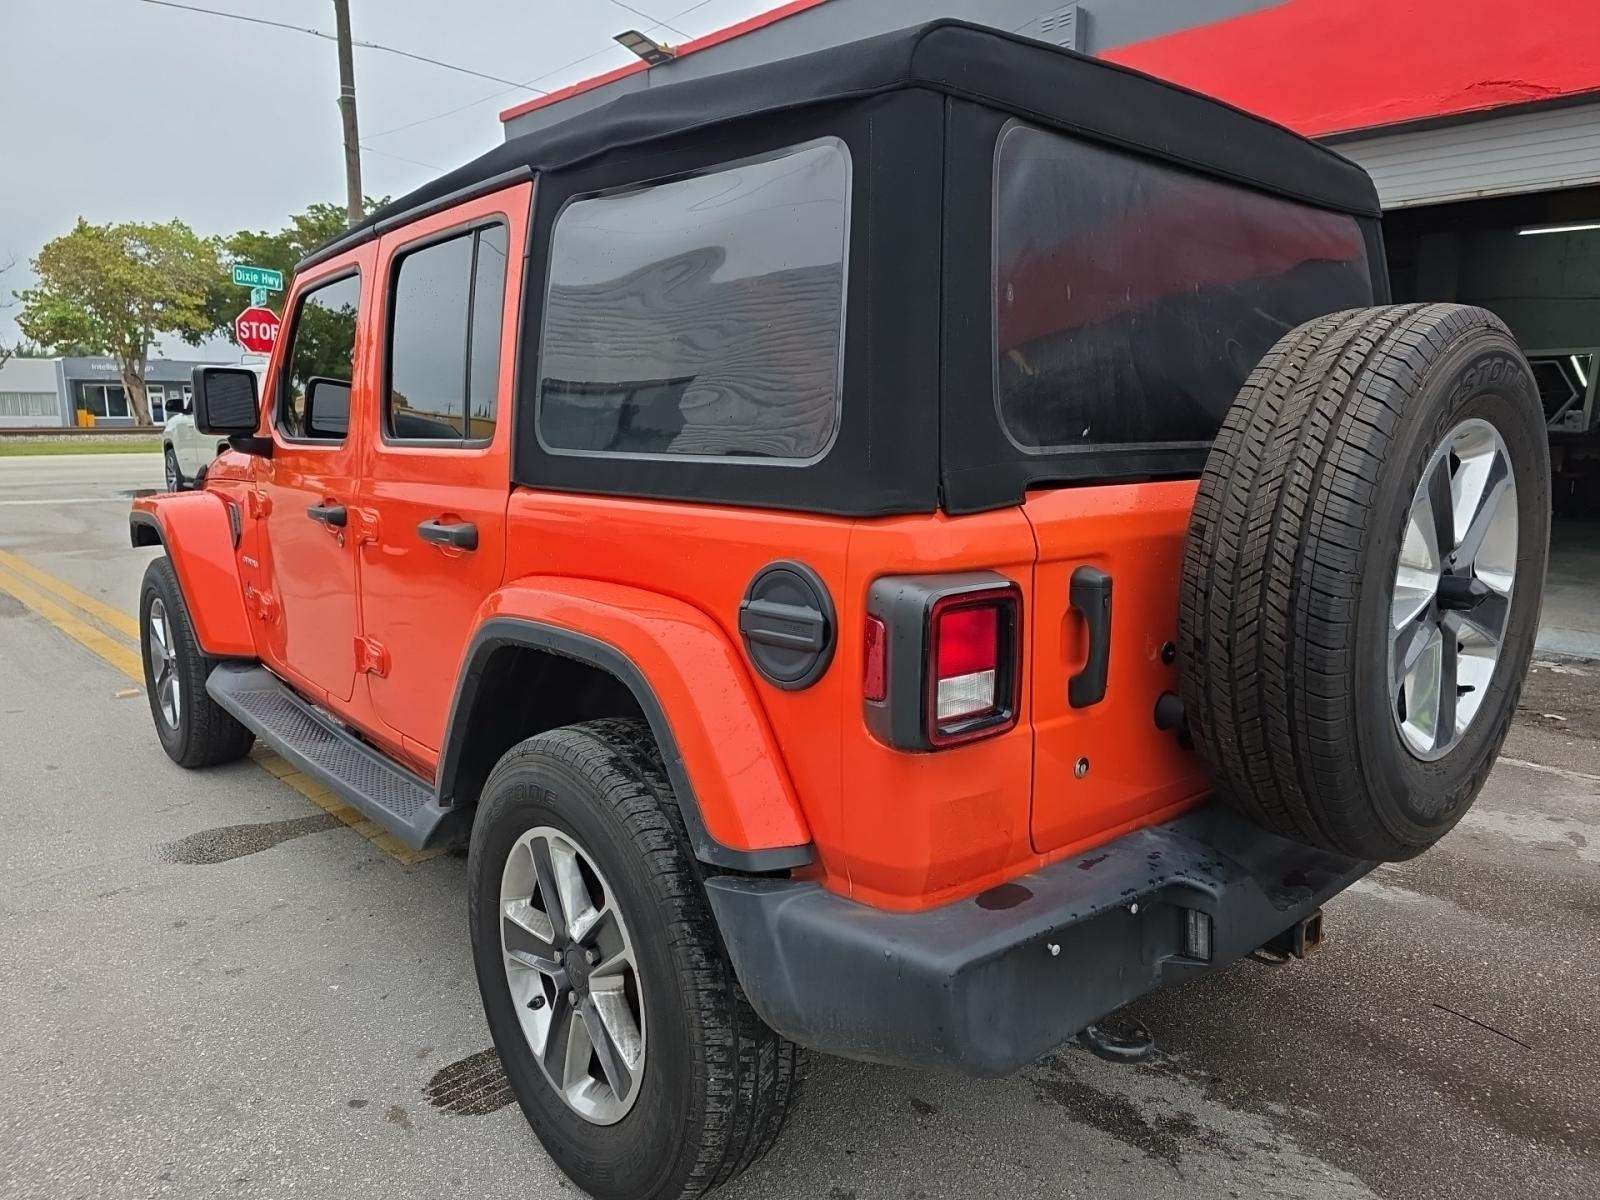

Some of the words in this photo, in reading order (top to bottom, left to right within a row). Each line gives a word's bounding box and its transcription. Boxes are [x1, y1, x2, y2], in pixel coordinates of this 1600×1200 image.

[236, 269, 258, 283] Dixie
[261, 273, 280, 287] Hwy
[240, 321, 280, 341] STOP
